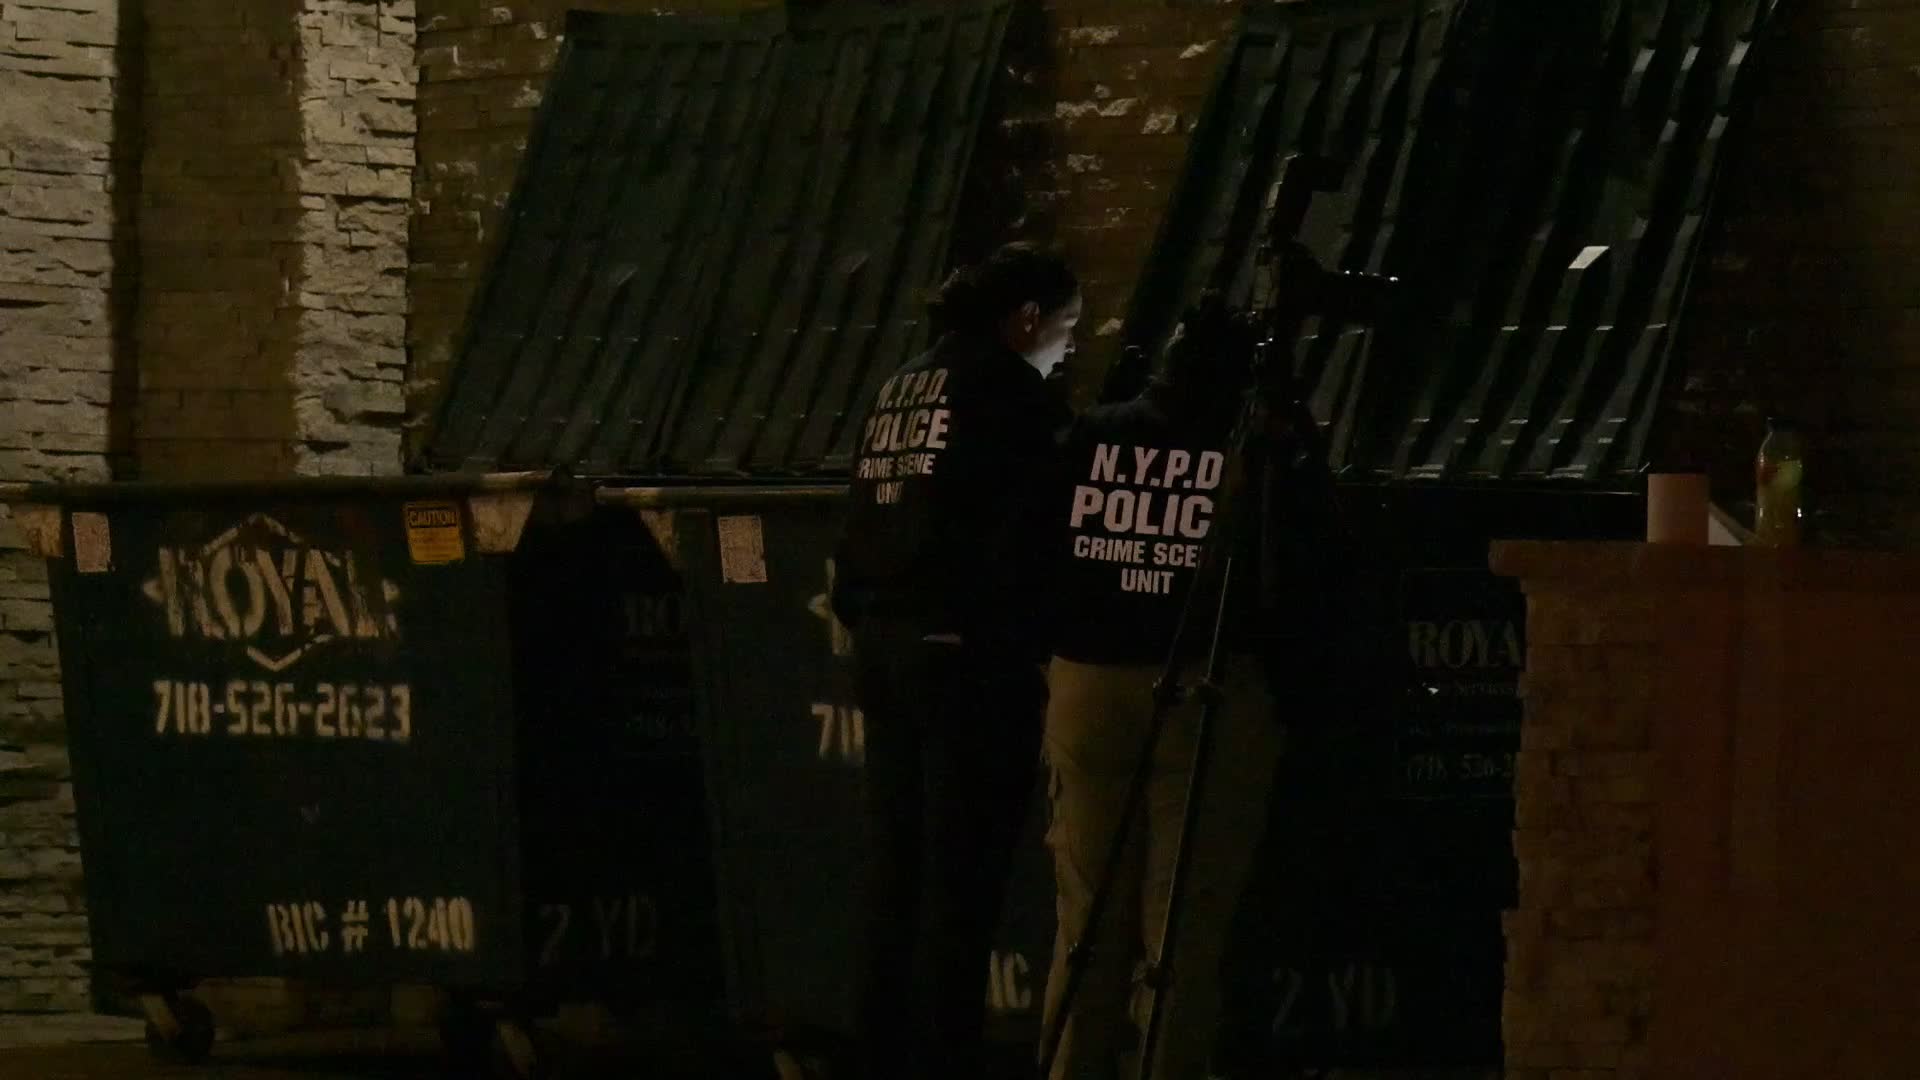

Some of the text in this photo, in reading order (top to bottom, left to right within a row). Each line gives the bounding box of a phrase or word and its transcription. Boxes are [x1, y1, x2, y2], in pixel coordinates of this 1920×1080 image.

[861, 408, 951, 455] POLICE
[858, 456, 896, 480] RIME
[1089, 443, 1224, 490] N.Y.P.D
[408, 510, 456, 526] CAUTION
[1069, 484, 1214, 539] POLIC
[1073, 535, 1200, 568] CRIME SCE
[1120, 567, 1175, 594] UNIT
[1407, 617, 1521, 669] ROYA
[152, 678, 413, 742] 718-526-2623
[266, 895, 478, 957] BIC # 1240
[985, 948, 1032, 1011] IC
